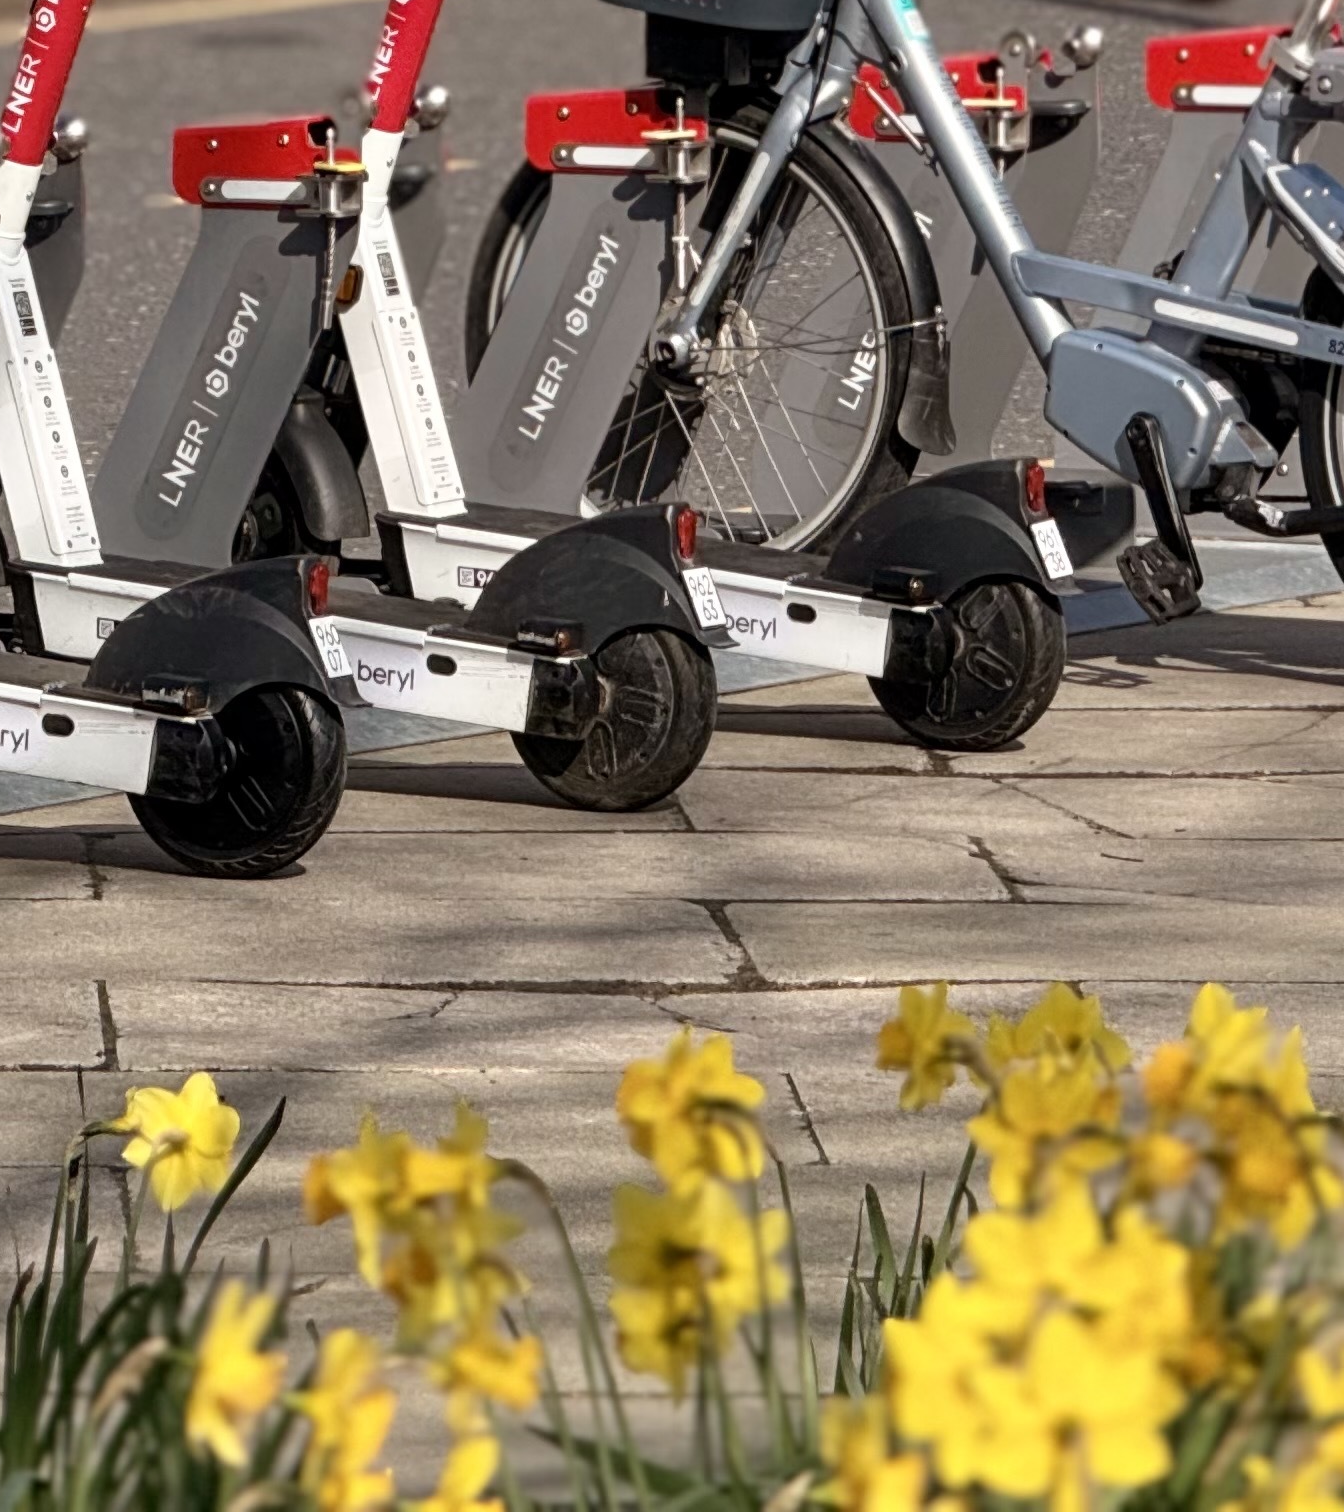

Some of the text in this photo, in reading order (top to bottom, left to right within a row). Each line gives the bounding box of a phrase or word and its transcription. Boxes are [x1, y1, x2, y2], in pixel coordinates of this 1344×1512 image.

[3, 53, 39, 134] LNER
[518, 234, 619, 441] LNER beryl
[159, 292, 261, 508] LNER beryl
[1038, 528, 1060, 548] 961
[689, 575, 714, 597] 962
[703, 599, 718, 620] 63
[316, 624, 340, 647] 960
[327, 649, 343, 672] 07
[358, 659, 414, 692] beryl
